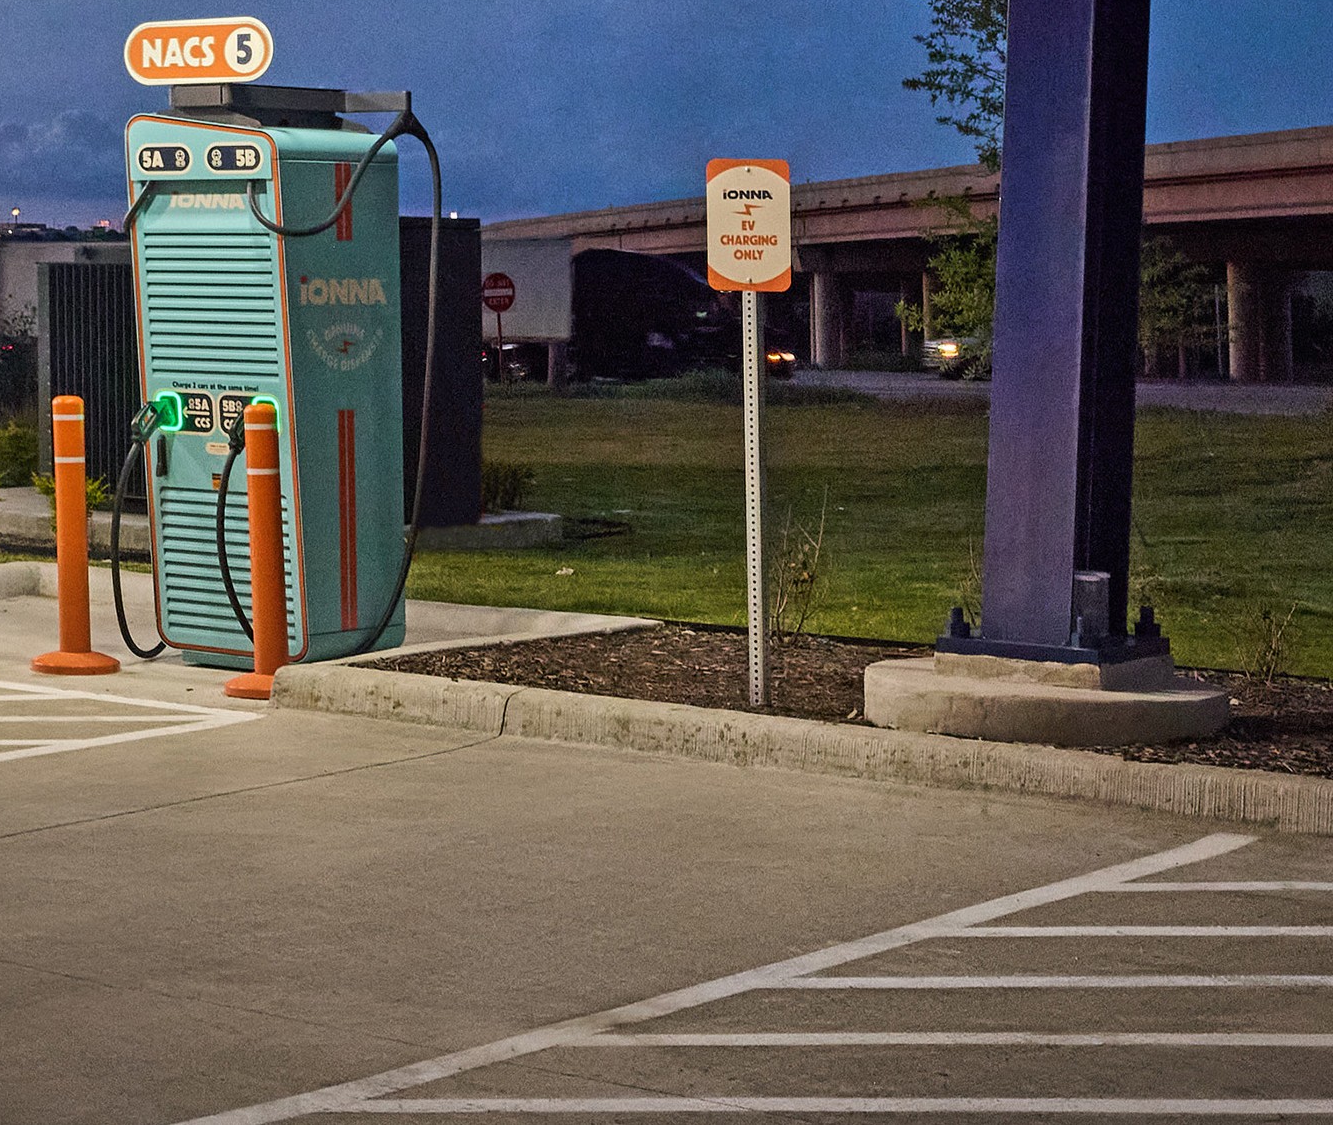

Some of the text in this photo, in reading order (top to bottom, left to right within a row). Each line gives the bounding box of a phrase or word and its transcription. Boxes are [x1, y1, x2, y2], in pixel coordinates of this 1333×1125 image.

[142, 33, 253, 68] NACS 5
[142, 149, 164, 168] 5A
[235, 148, 257, 167] 5B
[741, 220, 755, 231] EV
[720, 234, 778, 246] CHARGING
[733, 249, 764, 260] ONLY
[195, 398, 210, 411] 5A
[222, 398, 235, 411] 5B
[194, 417, 211, 428] CCS
